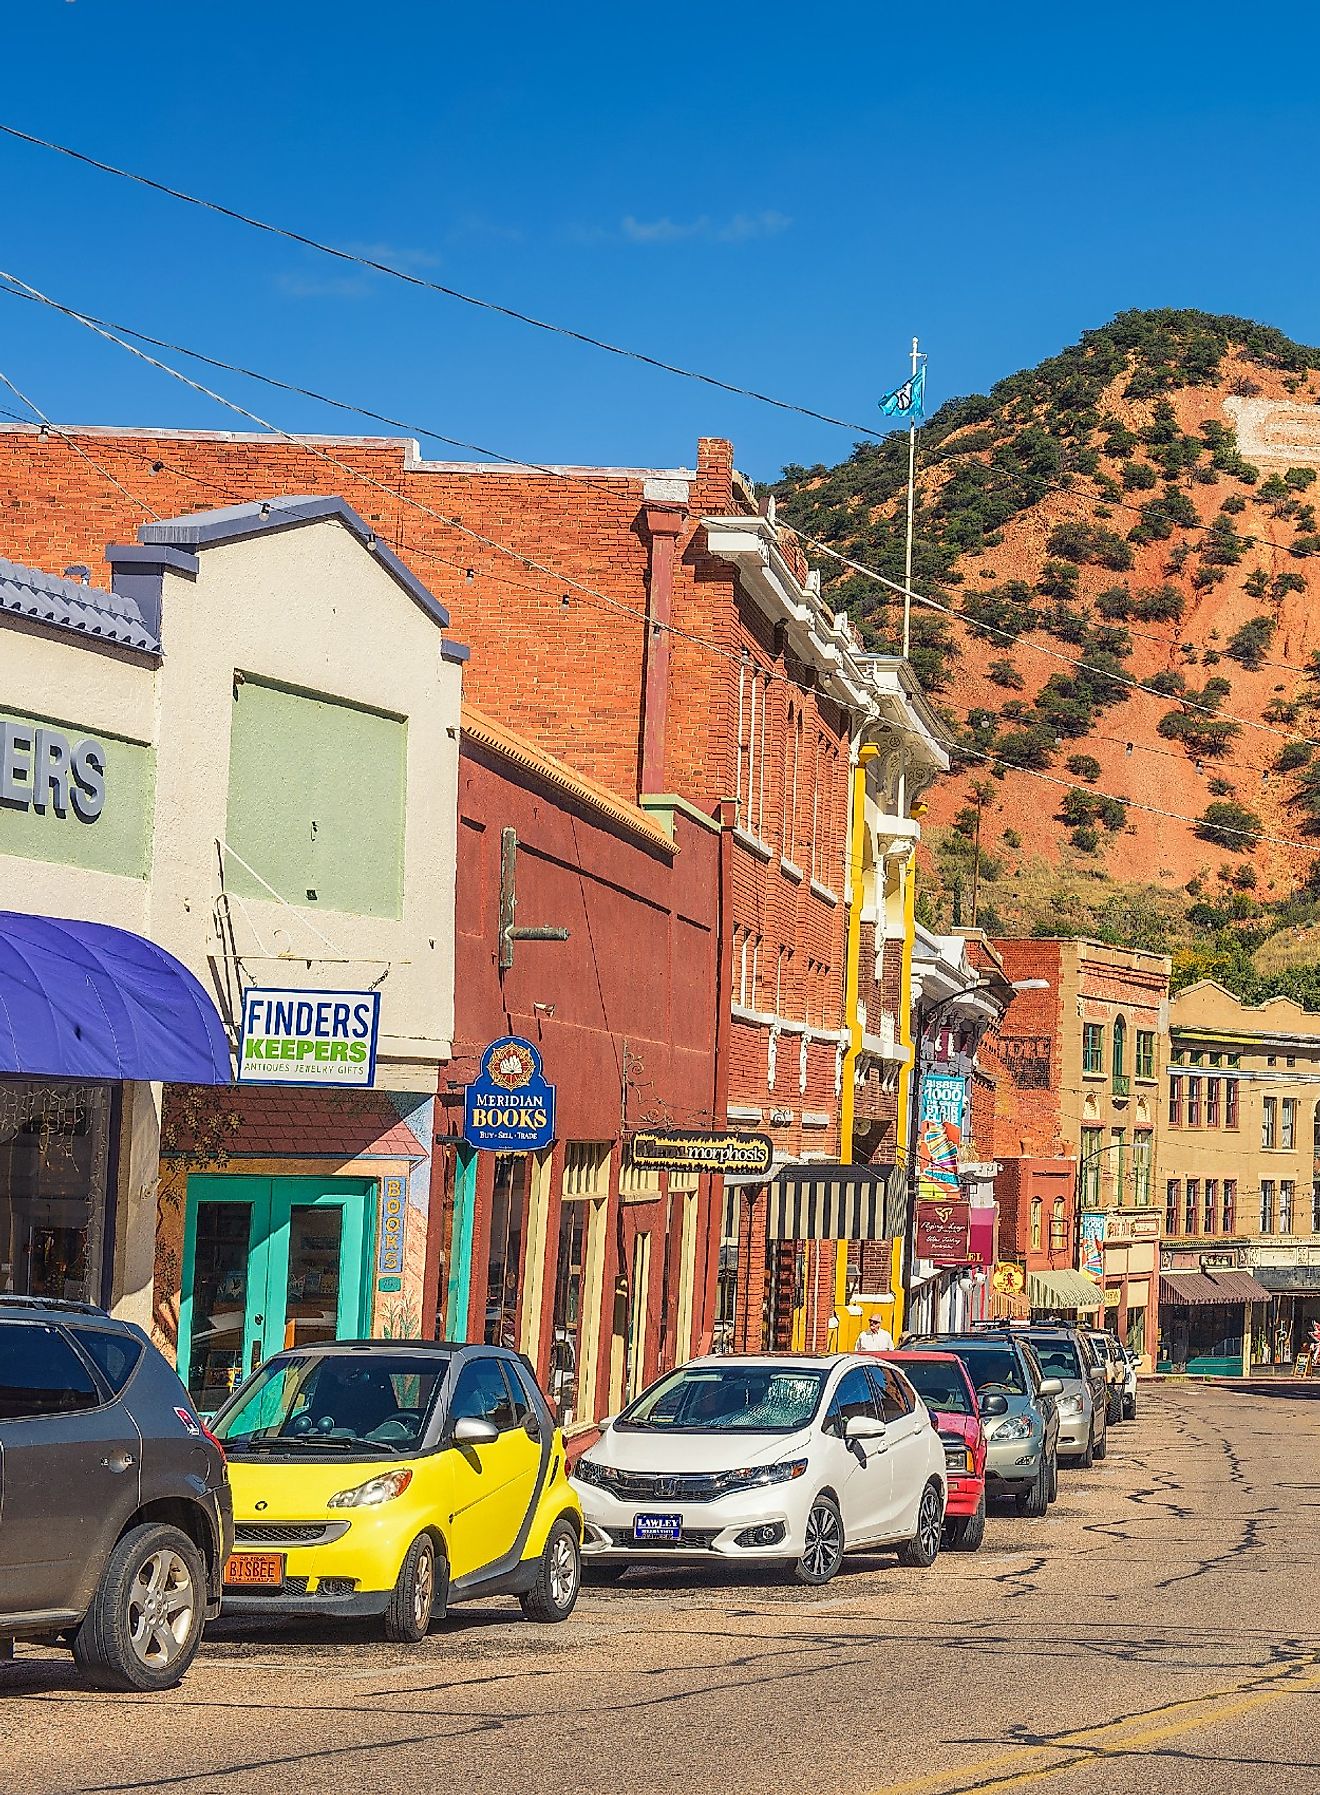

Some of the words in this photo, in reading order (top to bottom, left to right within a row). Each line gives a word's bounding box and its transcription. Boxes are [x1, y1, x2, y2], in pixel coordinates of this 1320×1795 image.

[247, 1000, 370, 1038] FINDERS
[245, 1039, 367, 1063] KEEPERS
[244, 1063, 290, 1072] ANTIQUES
[294, 1064, 334, 1075] JEWELRY
[337, 1065, 364, 1075] GIFTS
[926, 1080, 962, 1089] BISBEE
[476, 1094, 543, 1107] MERIDIAN
[925, 1088, 962, 1101] 1000
[472, 1108, 548, 1131] BOOKS
[385, 1180, 402, 1270] BOOKS
[638, 1518, 679, 1528] LAWLEY
[230, 1561, 275, 1577] BISBEE
